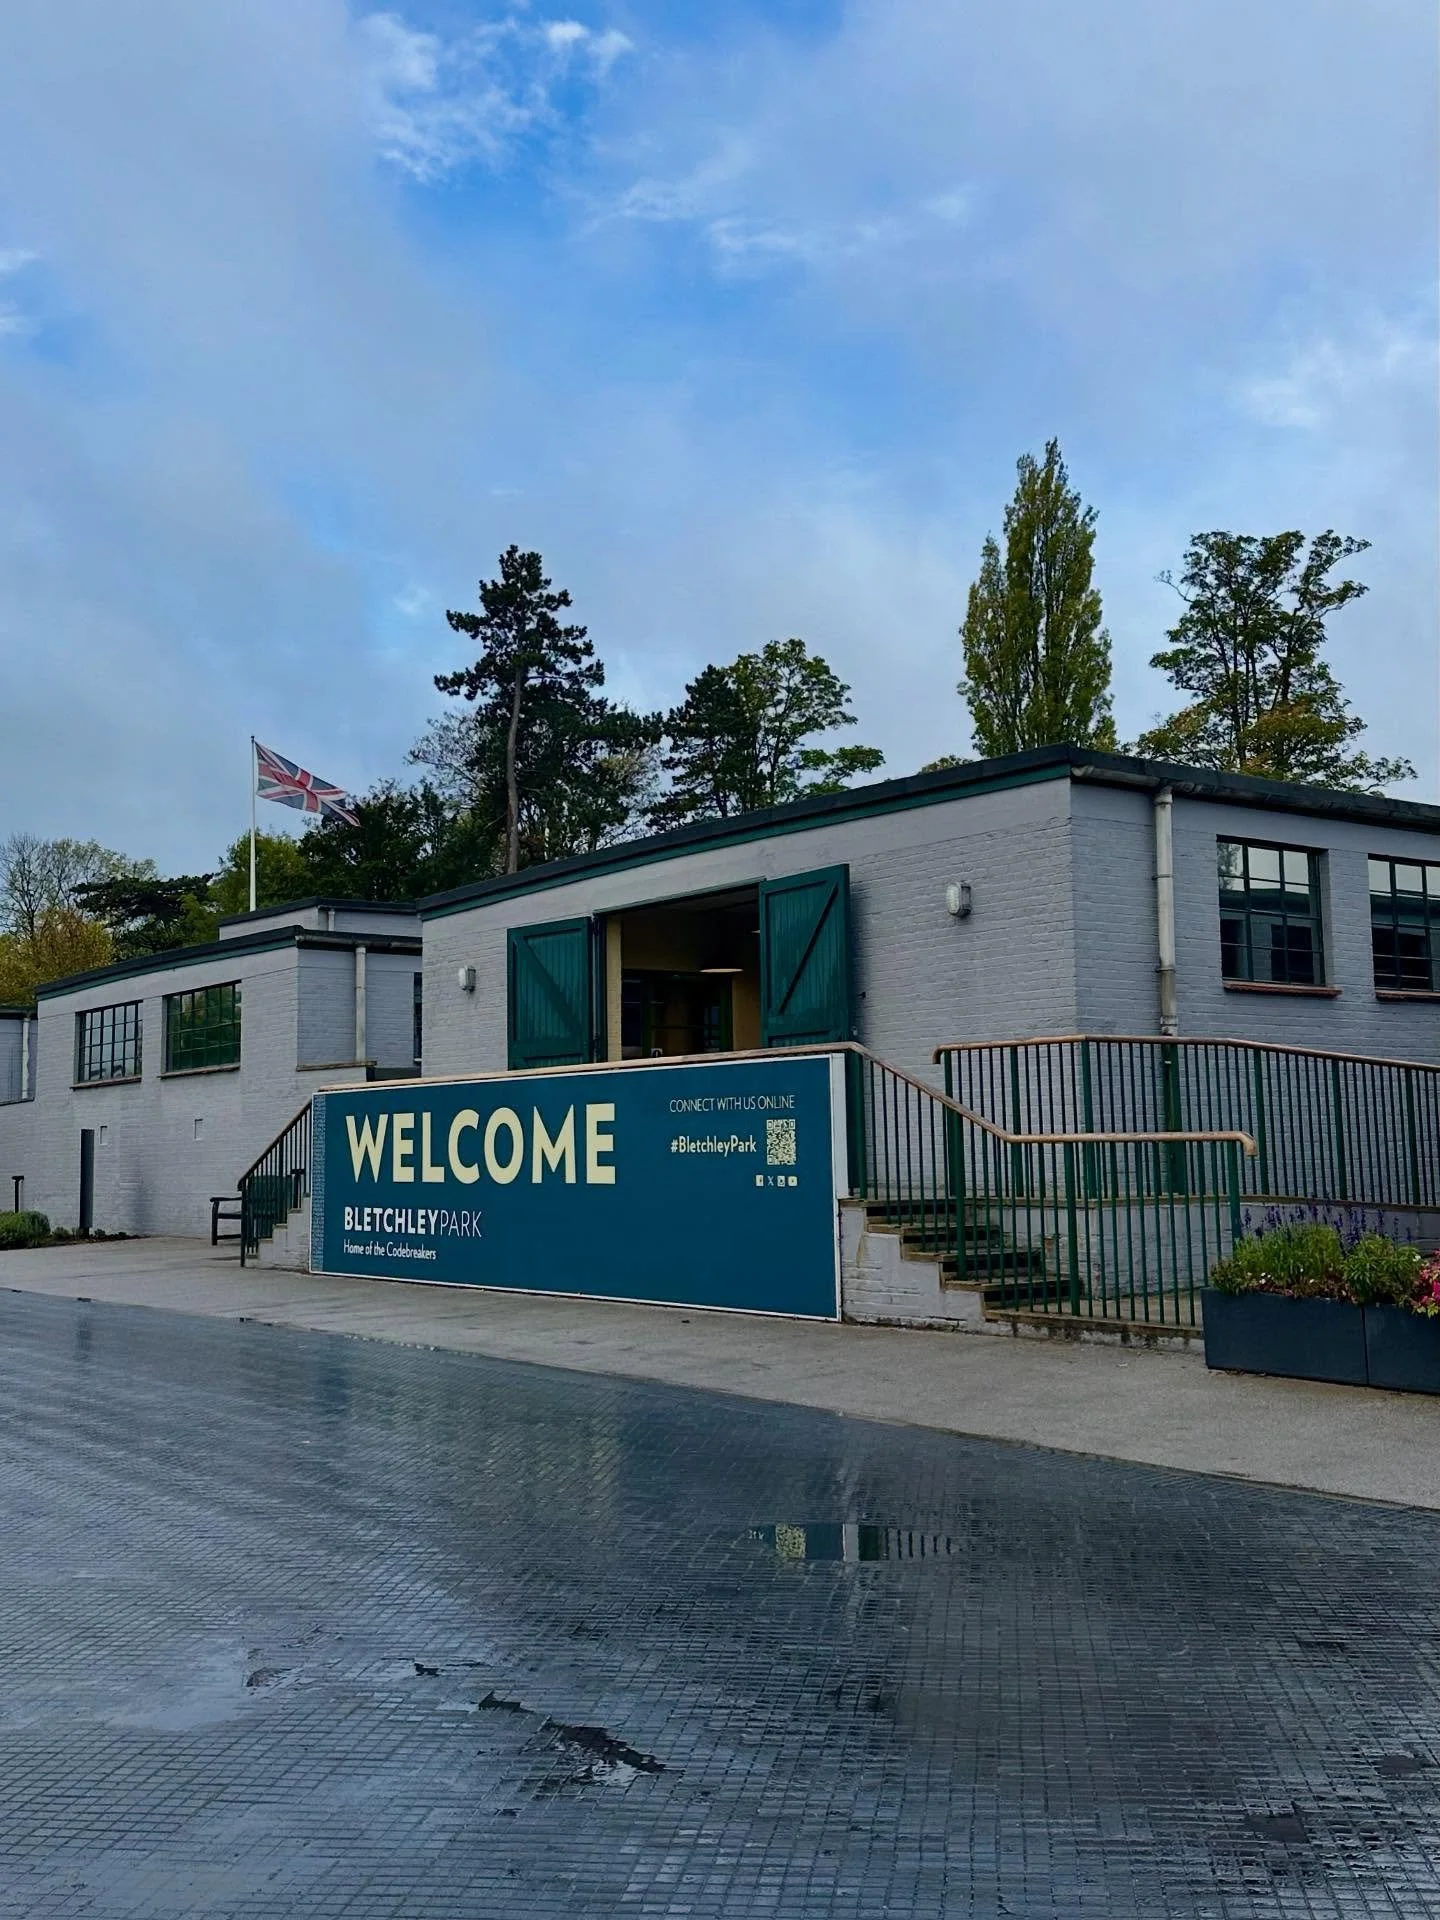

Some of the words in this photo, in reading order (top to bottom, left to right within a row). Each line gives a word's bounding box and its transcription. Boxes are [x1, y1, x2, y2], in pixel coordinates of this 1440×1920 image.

[669, 1098, 715, 1112] CONNECT
[717, 1097, 742, 1110] WITH
[743, 1096, 756, 1110] US
[757, 1095, 796, 1109] ONLINE
[345, 1103, 616, 1185] WELCOME
[670, 1135, 757, 1157] #BletchleyPark
[343, 1239, 364, 1255] Home
[365, 1241, 373, 1256] of
[374, 1241, 385, 1257] the
[386, 1241, 437, 1260] Codebreakers
